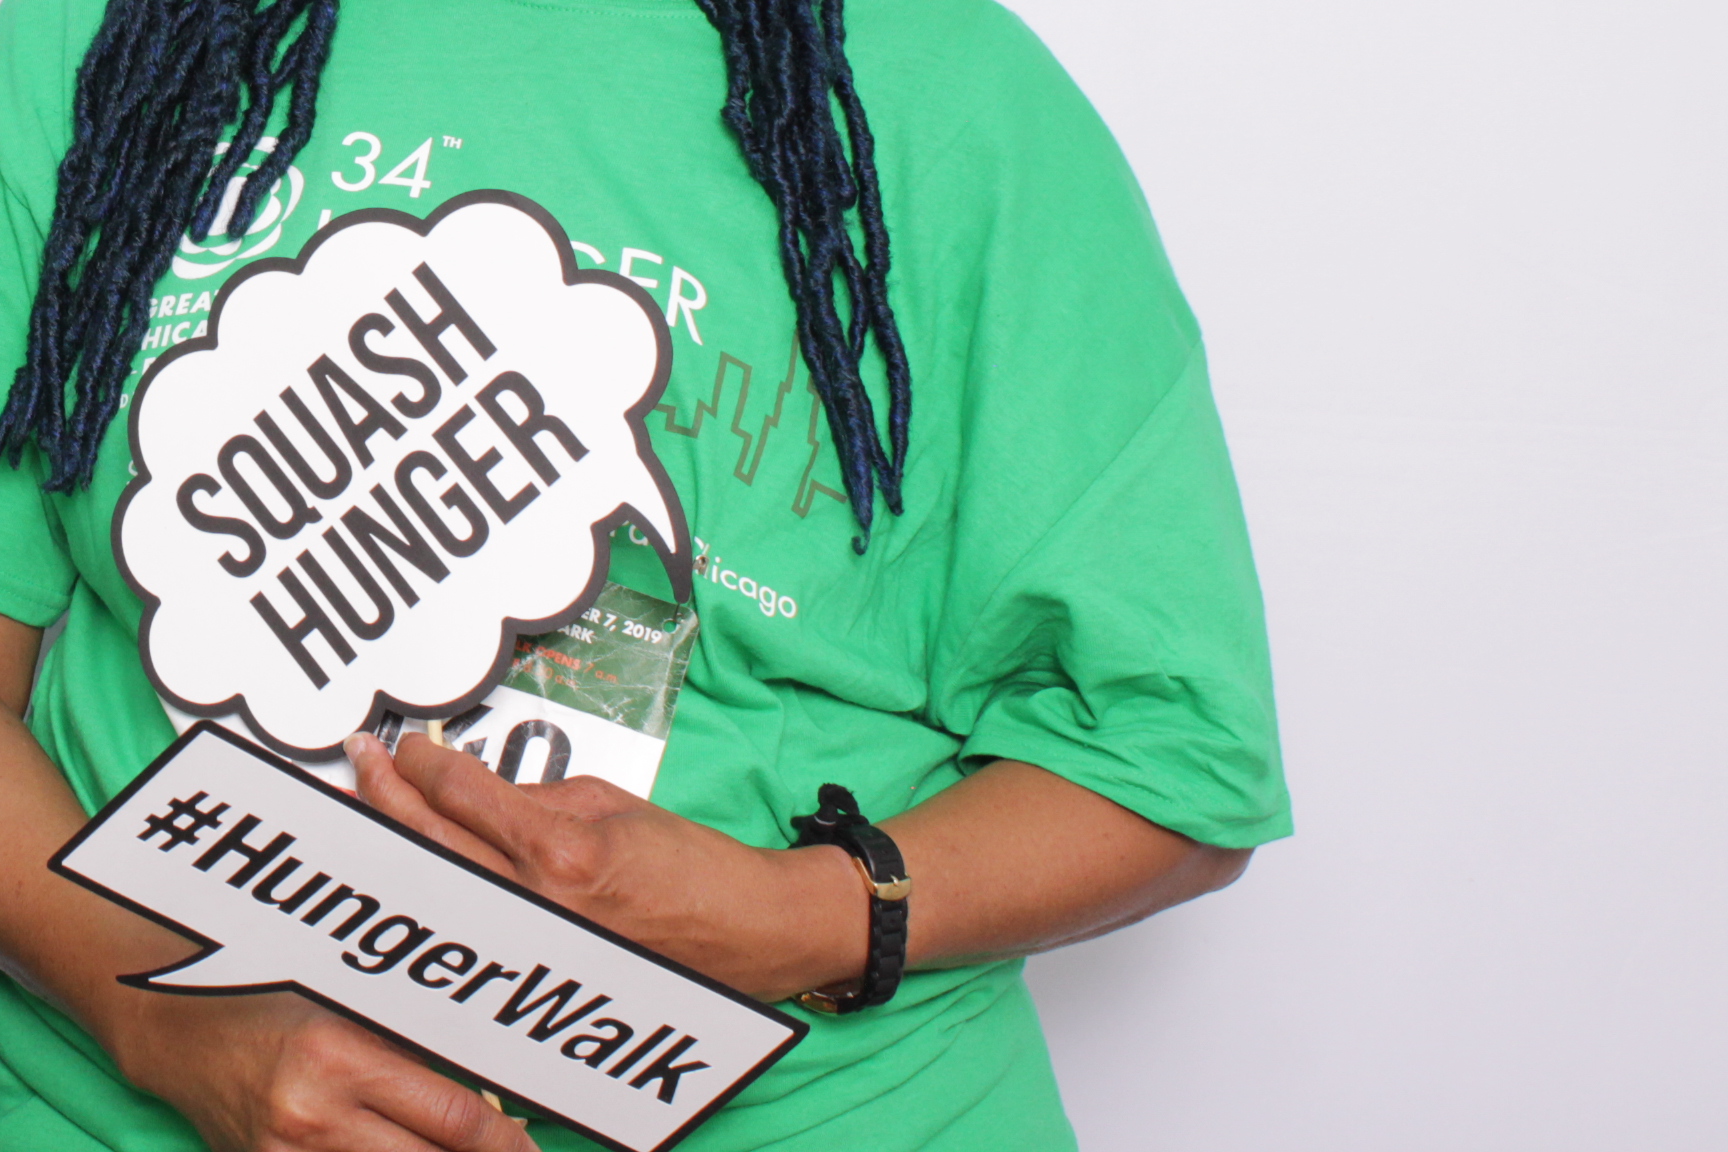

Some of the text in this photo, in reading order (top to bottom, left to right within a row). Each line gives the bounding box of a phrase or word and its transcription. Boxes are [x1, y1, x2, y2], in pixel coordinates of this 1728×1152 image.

[175, 260, 499, 579] SQUASH
[248, 369, 591, 692] HUNGER
[535, 646, 582, 671] OPENS
[556, 624, 594, 644] ARK
[622, 620, 663, 644] 2019
[136, 790, 713, 1106] #HungerWalk
